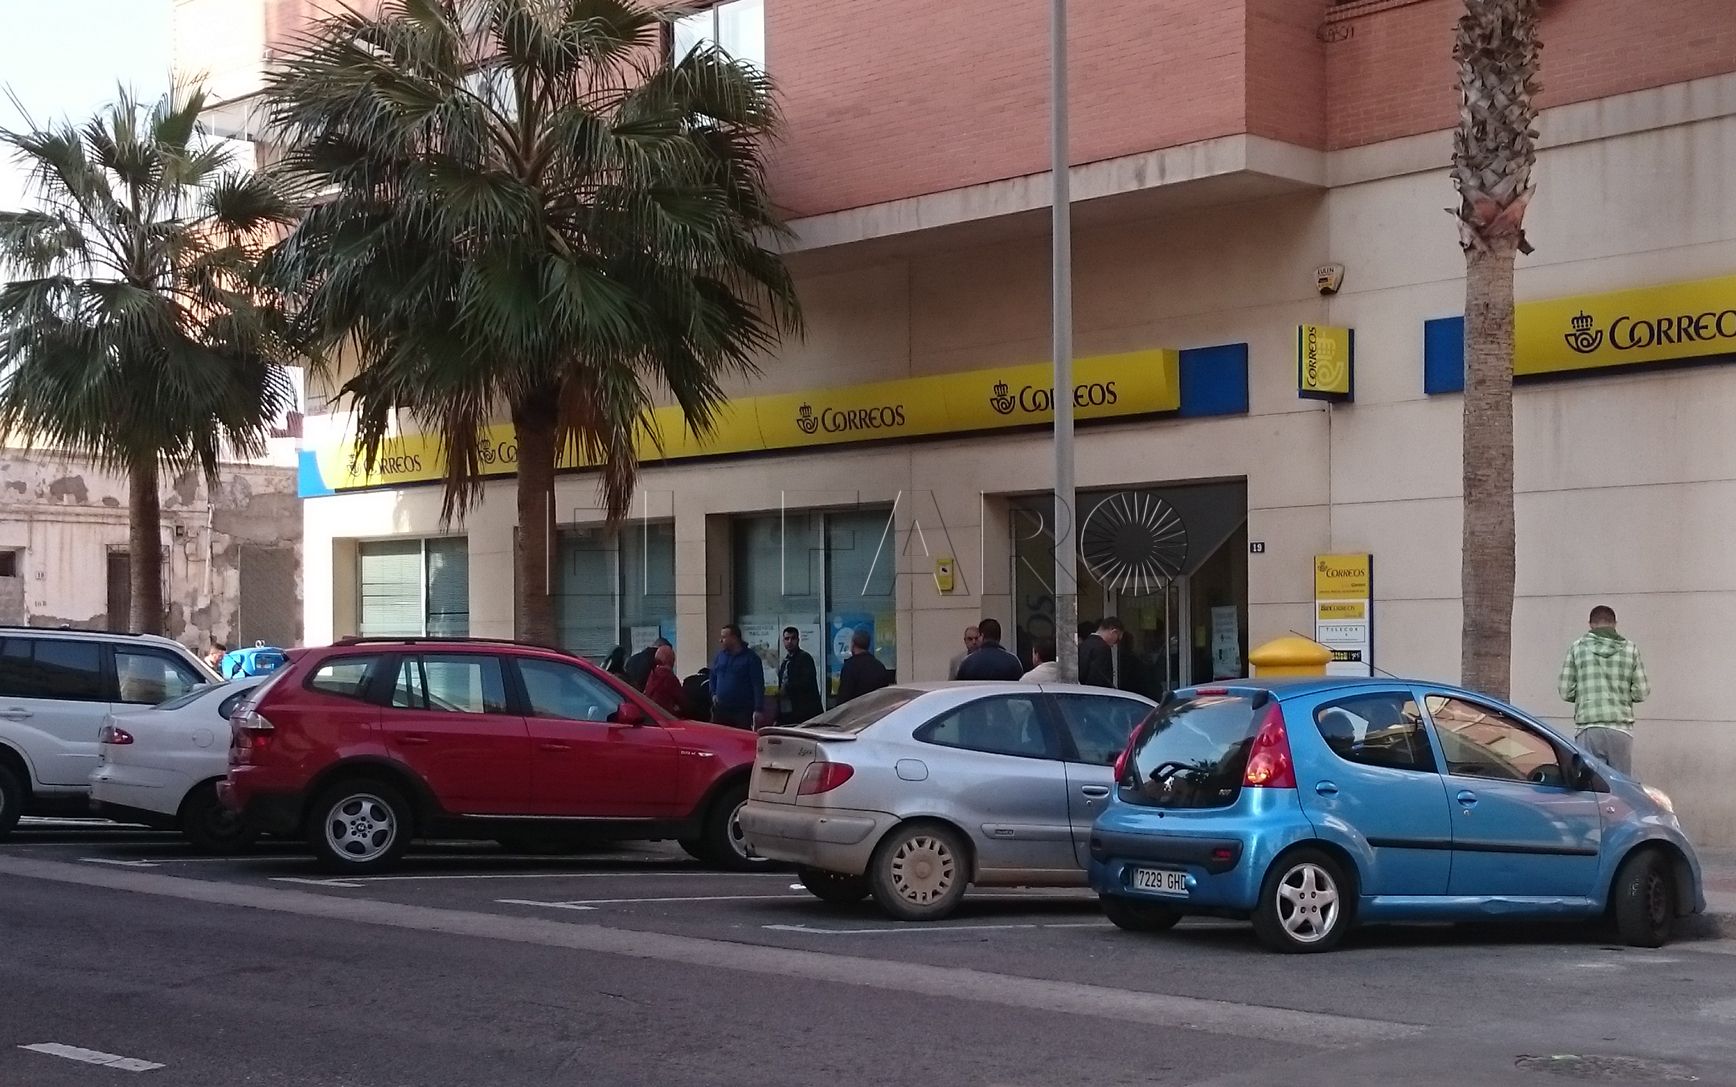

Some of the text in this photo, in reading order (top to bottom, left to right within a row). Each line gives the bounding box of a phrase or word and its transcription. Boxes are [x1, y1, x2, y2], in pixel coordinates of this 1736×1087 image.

[1307, 326, 1317, 387] CORREOS
[1019, 381, 1118, 413] COEOS
[821, 405, 906, 433] CORREOS
[1253, 543, 1263, 552] 19
[1326, 568, 1365, 578] CORREOS
[1139, 870, 1163, 888] 7229
